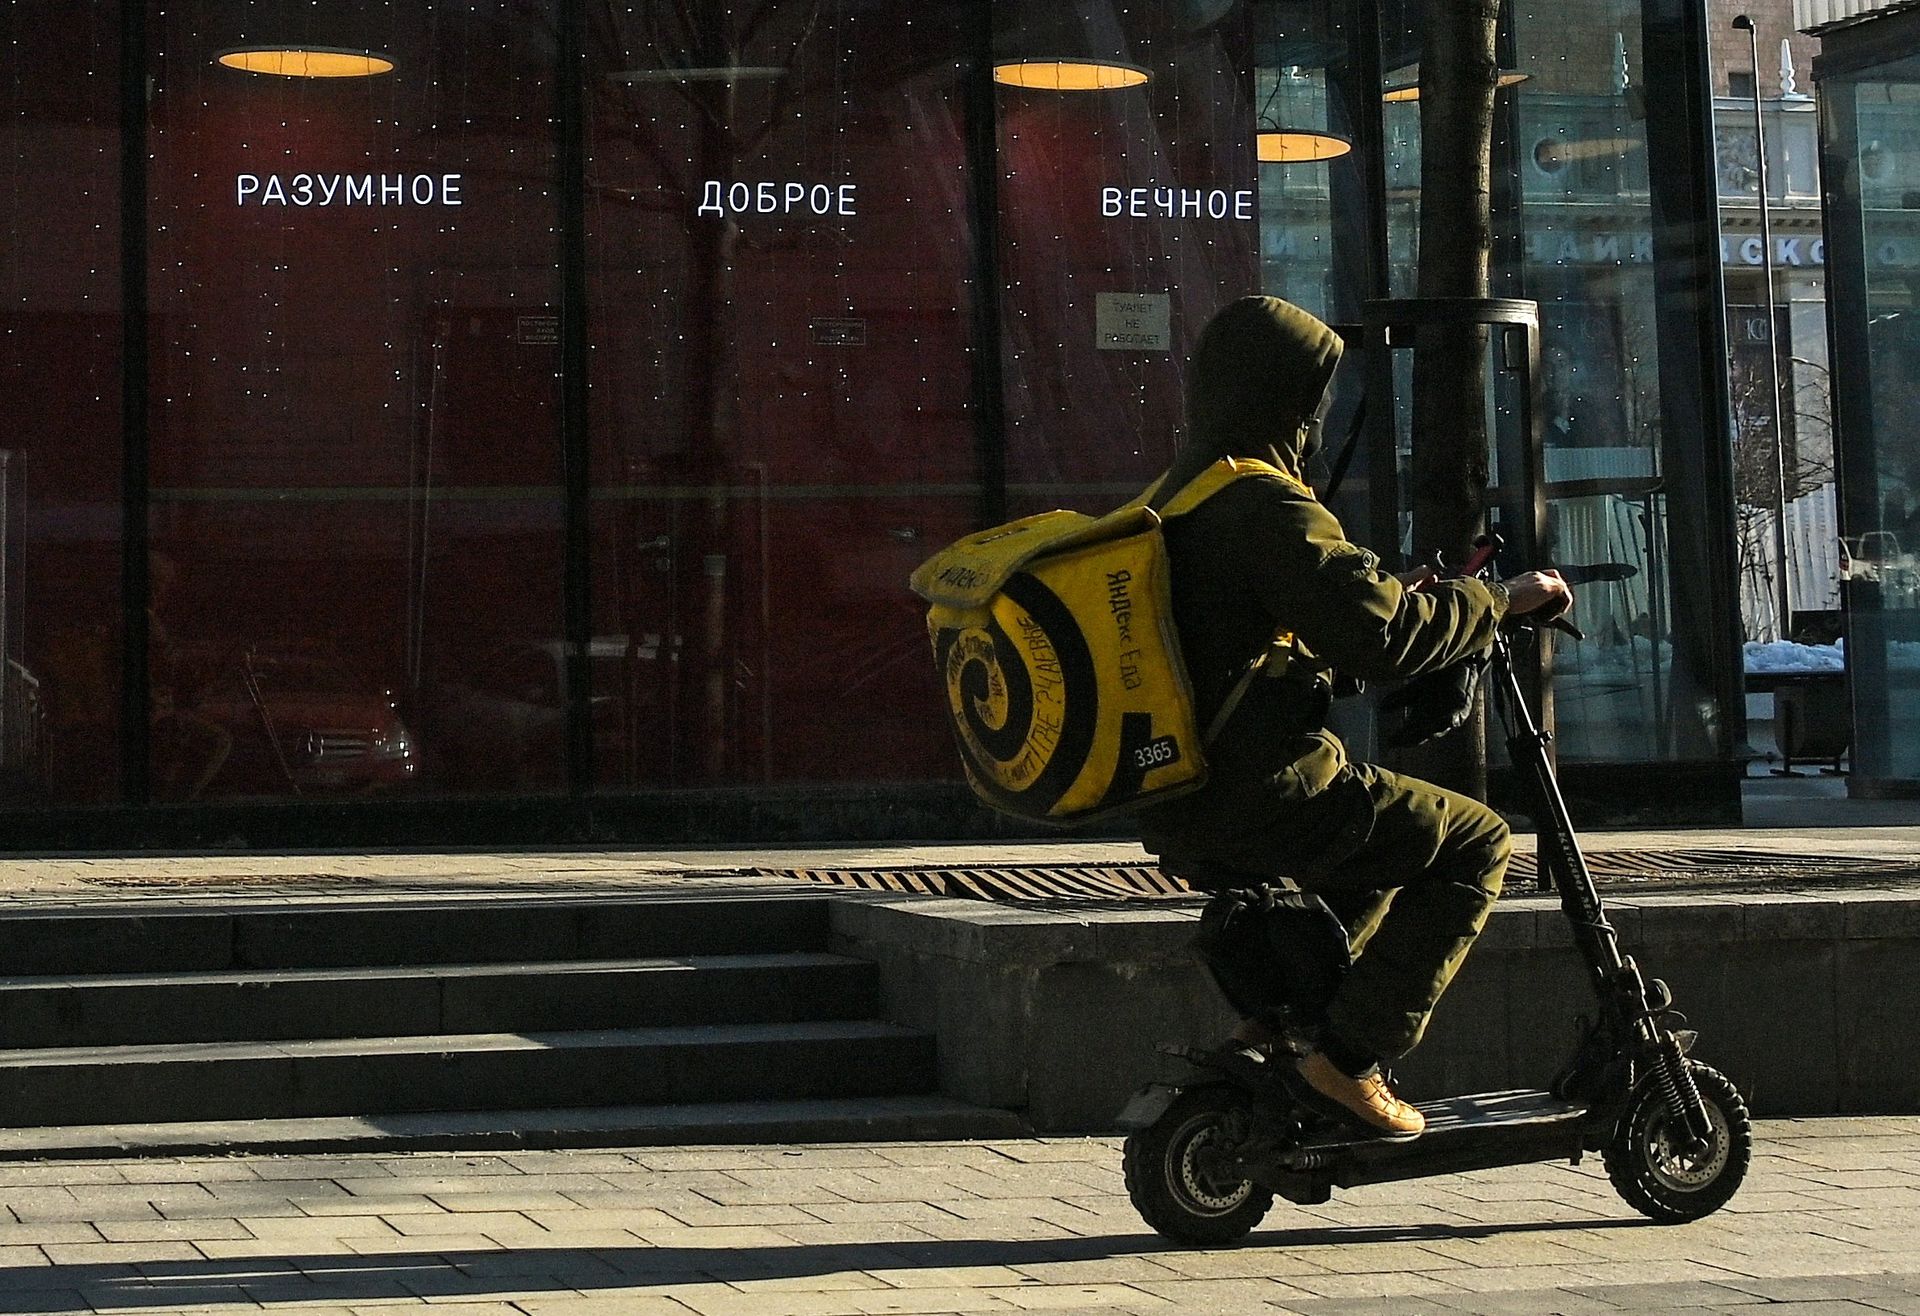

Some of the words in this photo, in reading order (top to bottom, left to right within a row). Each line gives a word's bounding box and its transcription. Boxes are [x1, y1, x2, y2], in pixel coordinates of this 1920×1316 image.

[236, 173, 463, 207] РАЗУМНОЕ
[697, 180, 858, 219] ДОБРОЕ
[1101, 186, 1254, 221] ВЕЧНОЕ
[1125, 319, 1140, 329] НЕ
[1106, 568, 1134, 645] Яндекс
[1120, 648, 1142, 691] Еда
[1134, 740, 1172, 768] 3365
